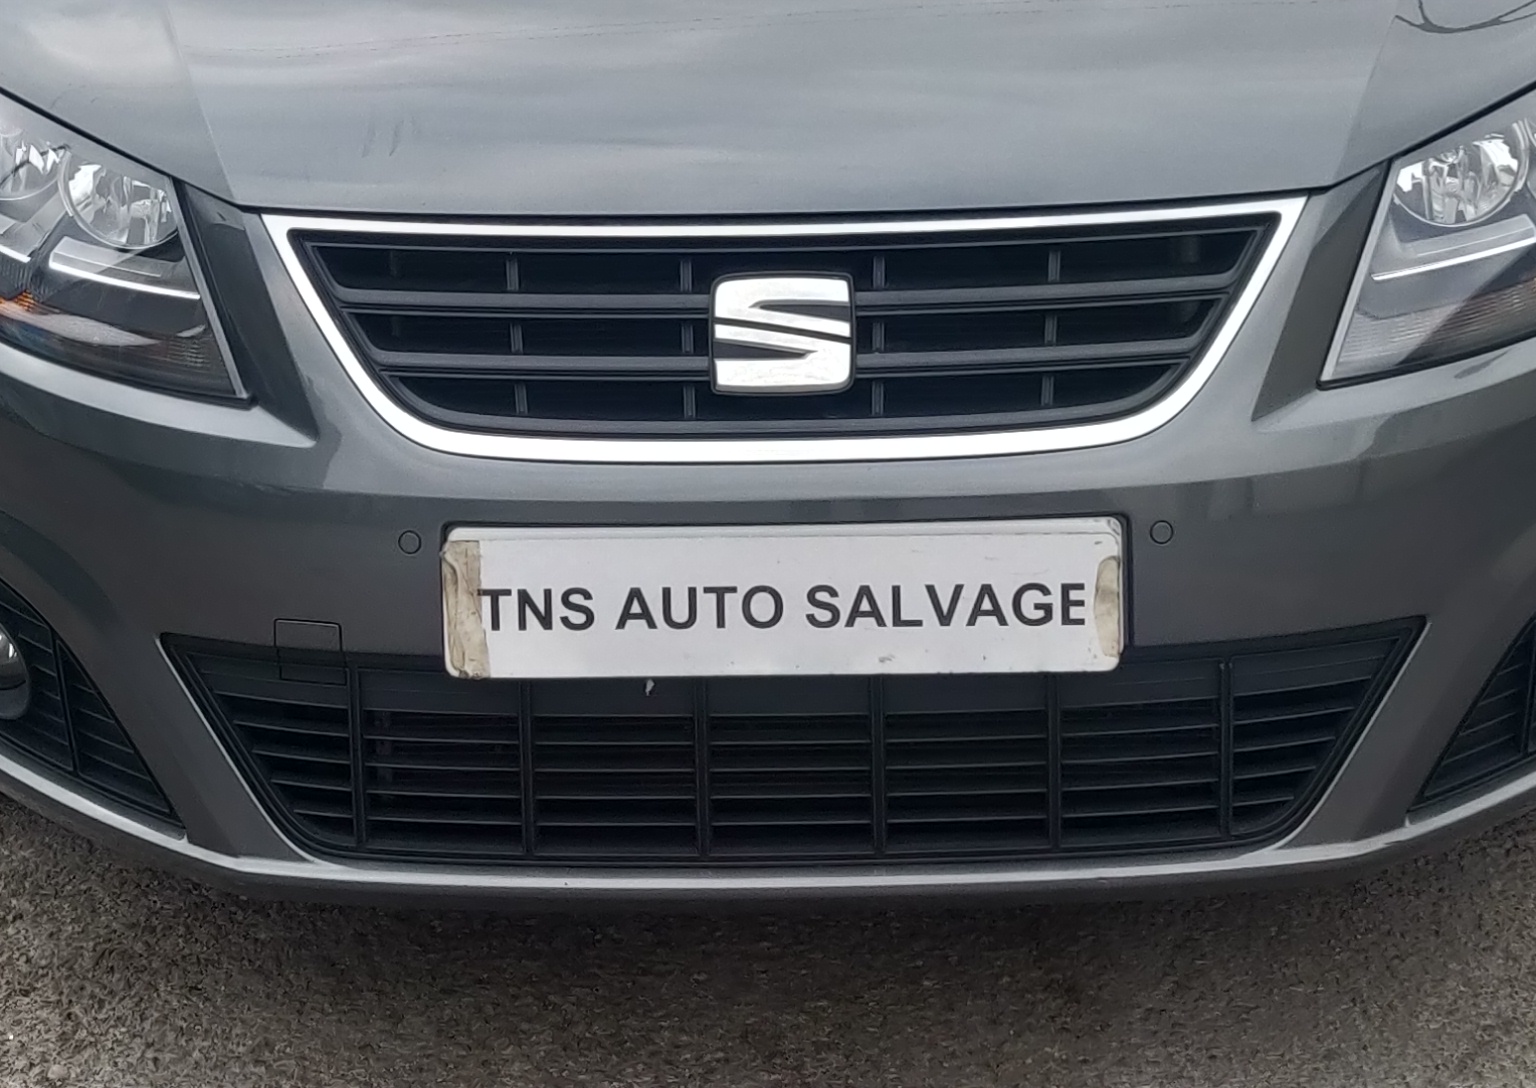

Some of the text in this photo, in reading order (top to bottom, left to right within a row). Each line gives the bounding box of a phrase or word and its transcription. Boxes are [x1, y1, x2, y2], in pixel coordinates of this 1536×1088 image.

[478, 581, 1086, 631] TNS AUTO SALVAGE
